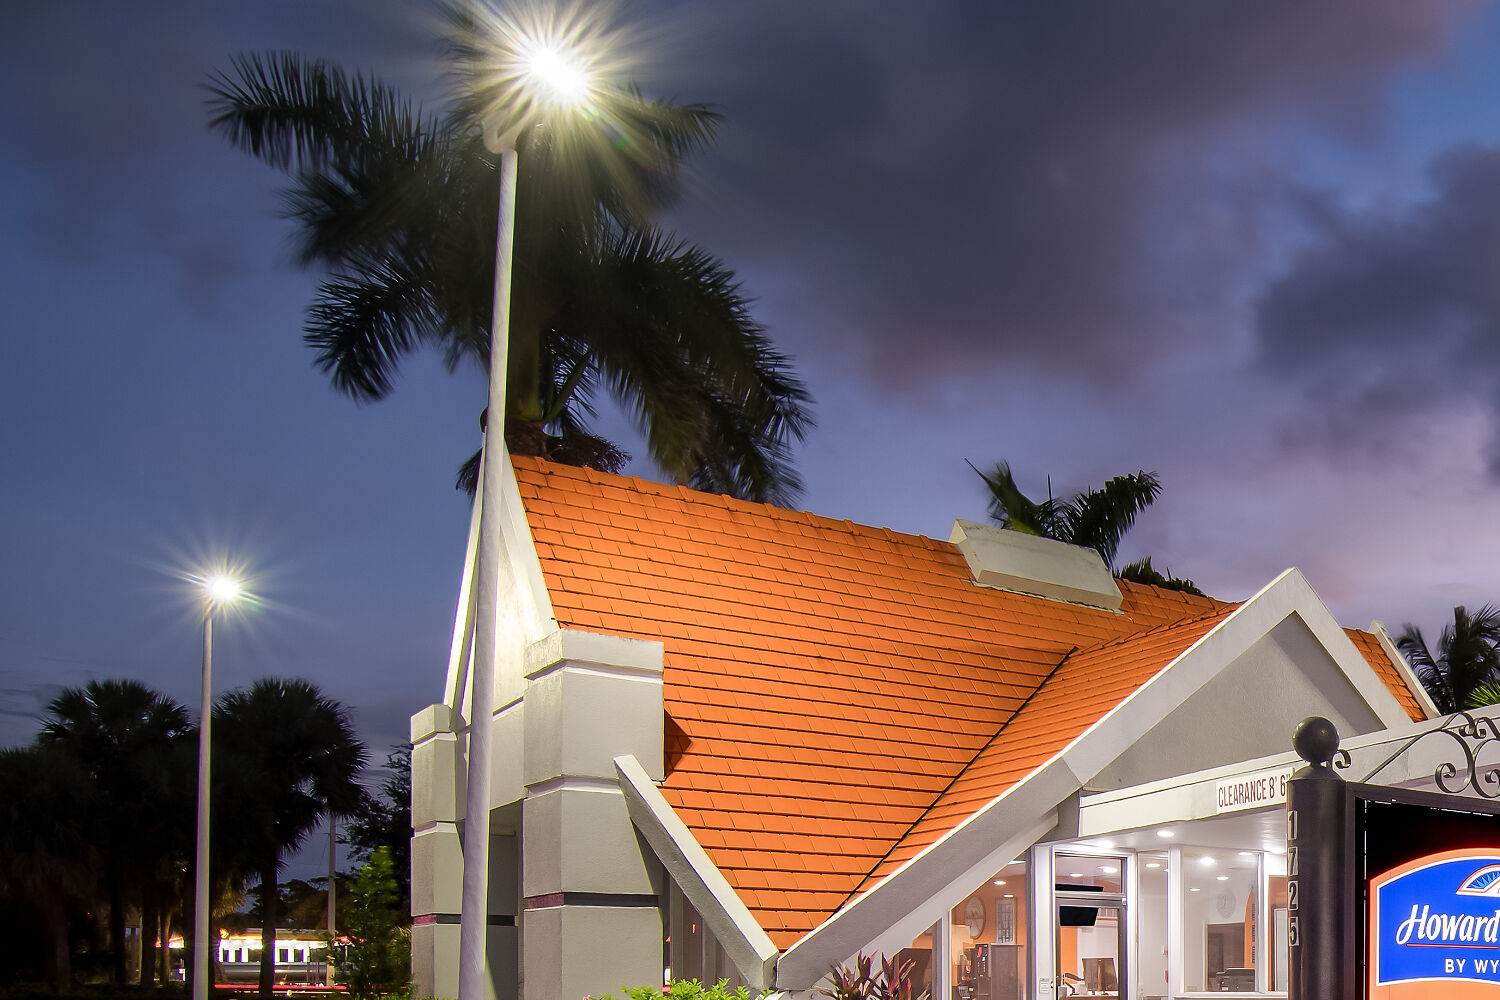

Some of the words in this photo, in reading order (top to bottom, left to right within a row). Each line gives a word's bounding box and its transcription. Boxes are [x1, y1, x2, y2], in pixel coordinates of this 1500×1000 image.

[1218, 778, 1267, 807] CLEARANCE
[1288, 810, 1299, 945] 1725
[1396, 904, 1500, 945] Howard
[1444, 958, 1466, 974] BY
